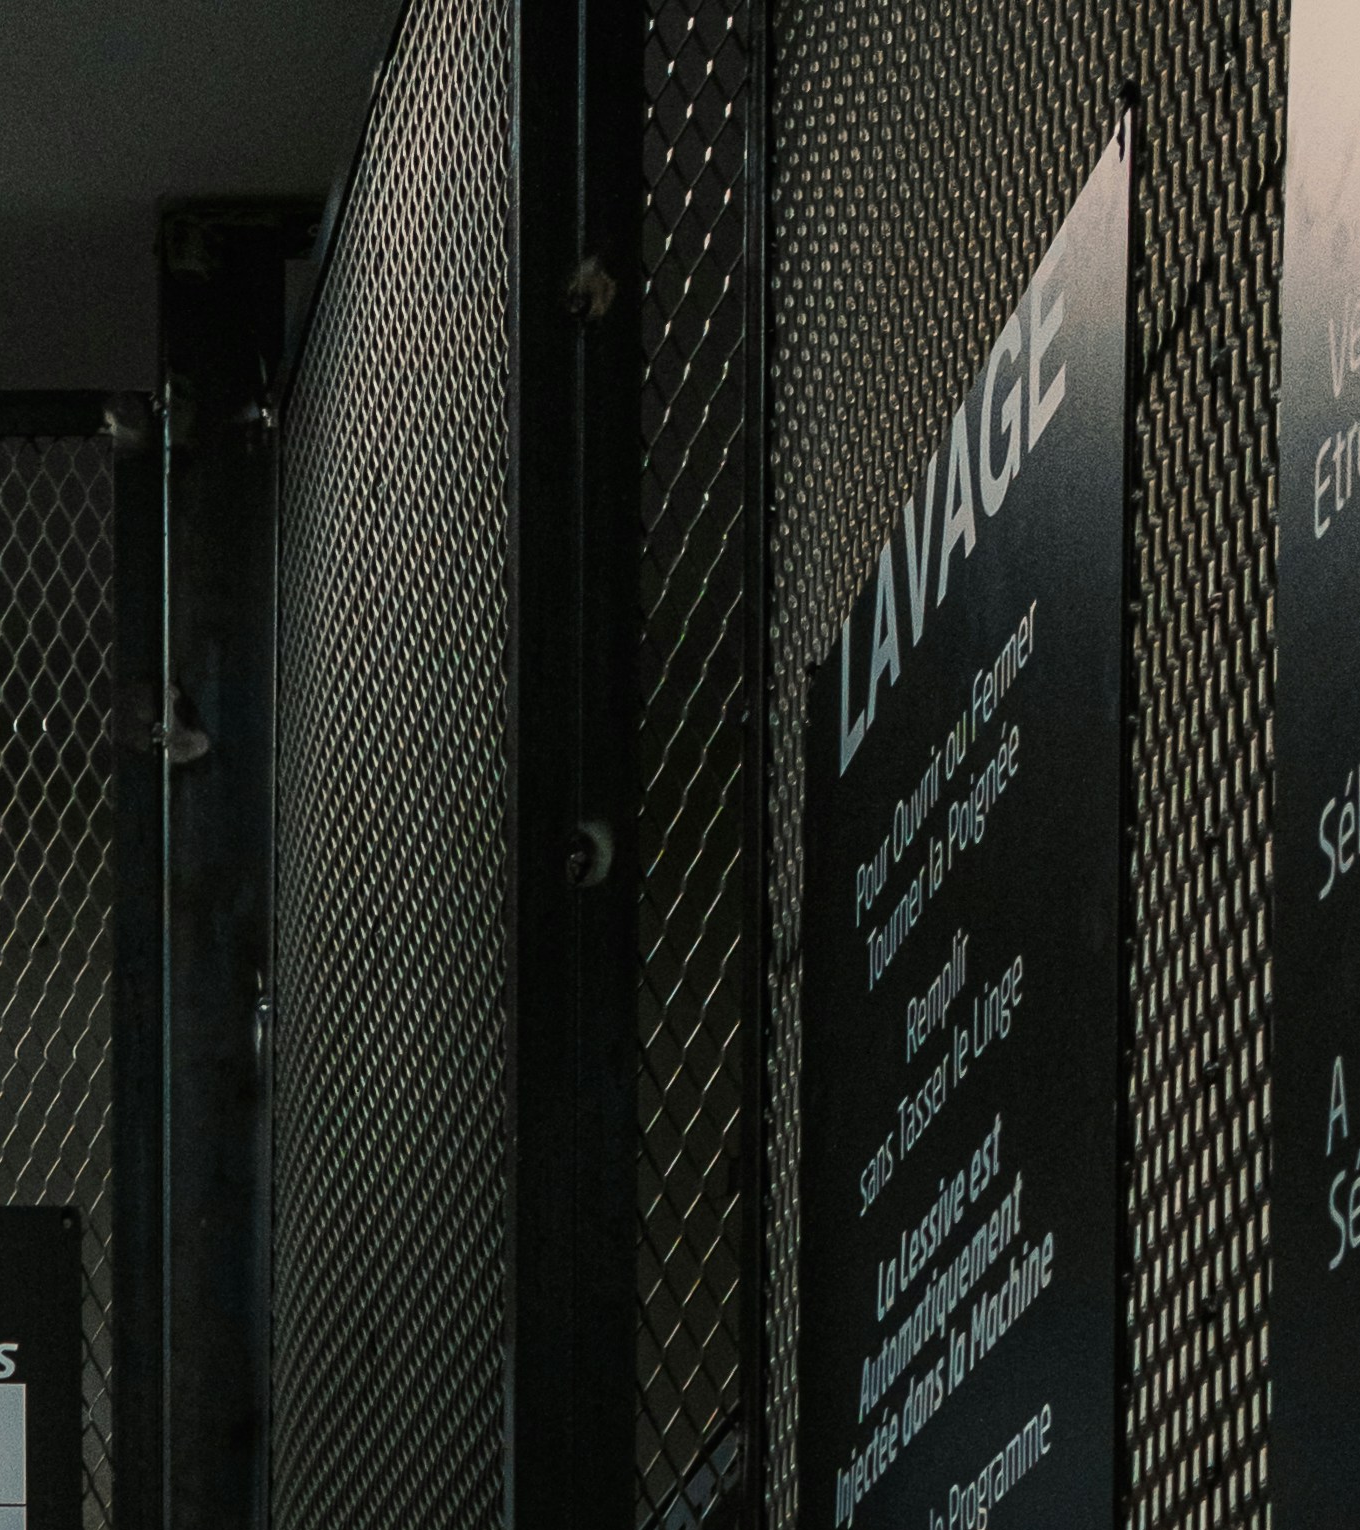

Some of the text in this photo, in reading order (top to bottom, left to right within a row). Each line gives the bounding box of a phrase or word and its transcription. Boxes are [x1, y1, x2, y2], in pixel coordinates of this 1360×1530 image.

[839, 223, 1067, 778] LAVAGE
[1314, 420, 1360, 540] Etr
[855, 598, 1038, 928] Pour Ouvrir ou Fermer
[867, 720, 1020, 992] Tourner la Poignée
[1319, 763, 1360, 900] Sé
[860, 954, 1024, 1218] sans Tasser le Linge
[906, 928, 969, 1064] Remplir
[1326, 1056, 1349, 1157] A
[858, 1170, 1023, 1424] Automatiquement
[876, 1111, 1003, 1323] La Lessive est
[835, 1232, 1055, 1530] Injectée dans la Machine
